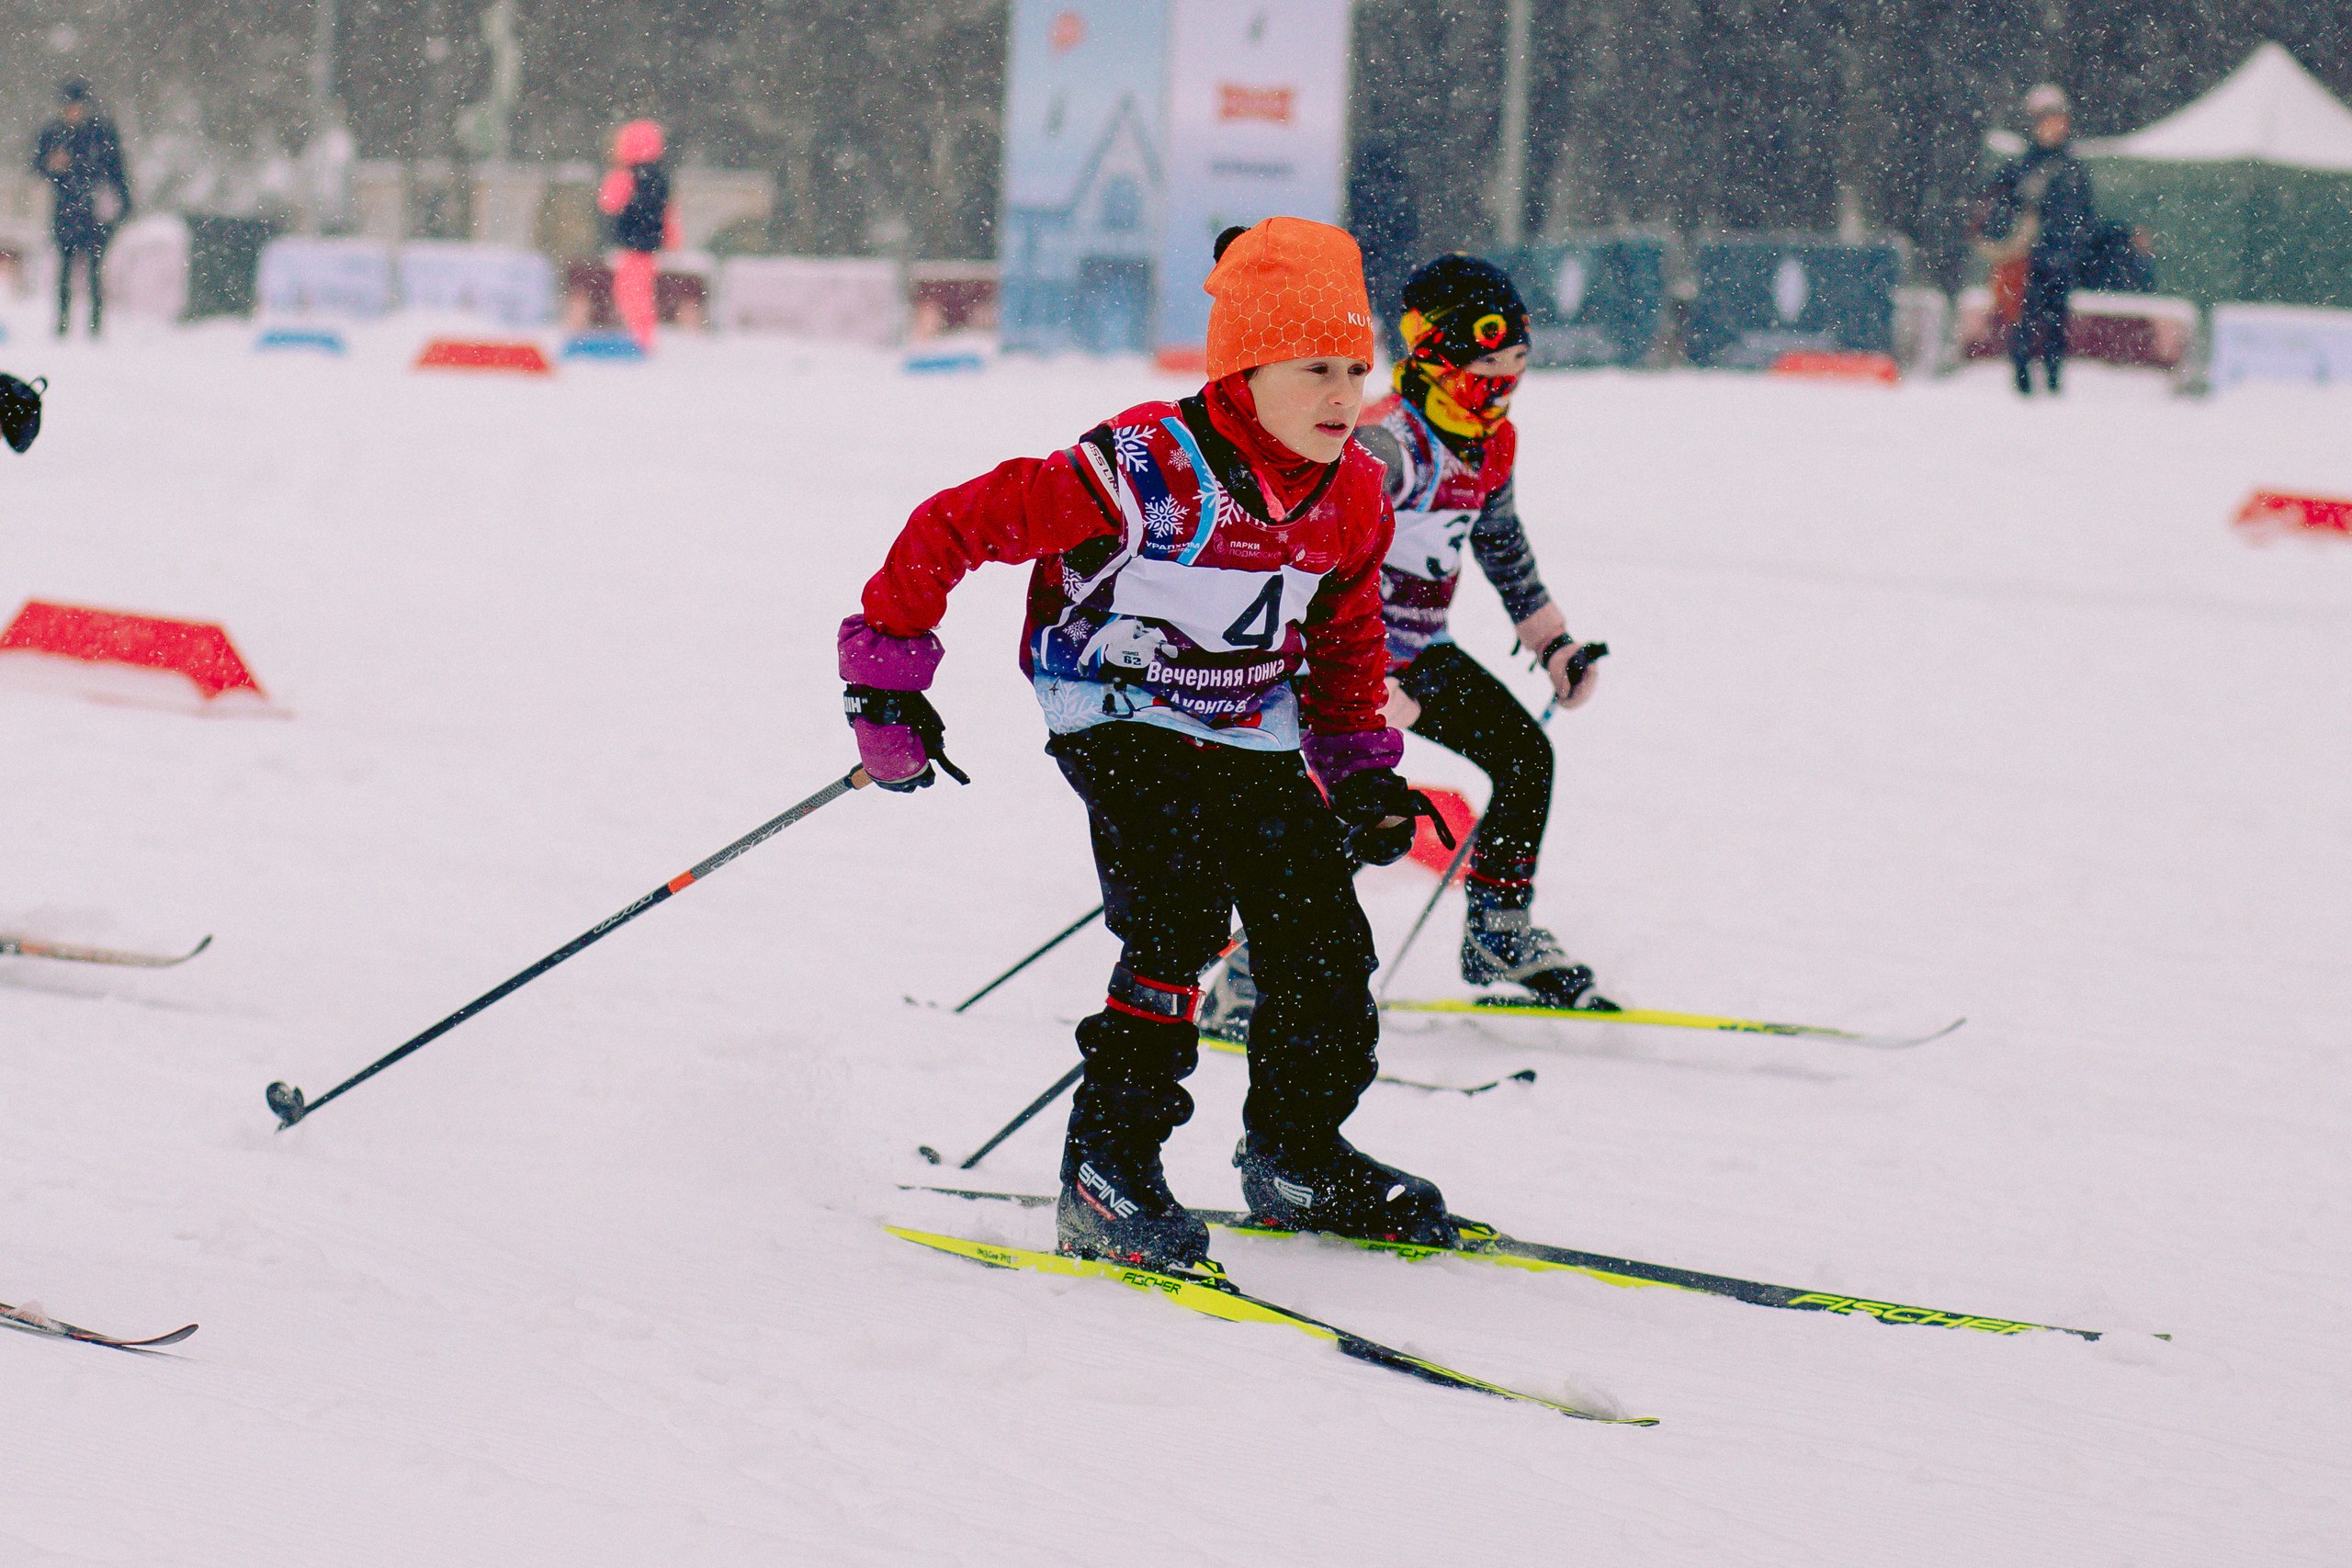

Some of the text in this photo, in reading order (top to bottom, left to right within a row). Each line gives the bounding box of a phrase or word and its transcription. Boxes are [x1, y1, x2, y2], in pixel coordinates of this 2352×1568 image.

[1145, 540, 1201, 551] УРАЛХИМ
[1229, 540, 1261, 551] ПАРКИ
[1222, 573, 1284, 650] 4
[1124, 655, 1142, 666] 62
[1146, 658, 1285, 691] Вечерняя гонка
[1078, 1162, 1139, 1219] SPINE
[1121, 1271, 1182, 1295] FISCHER
